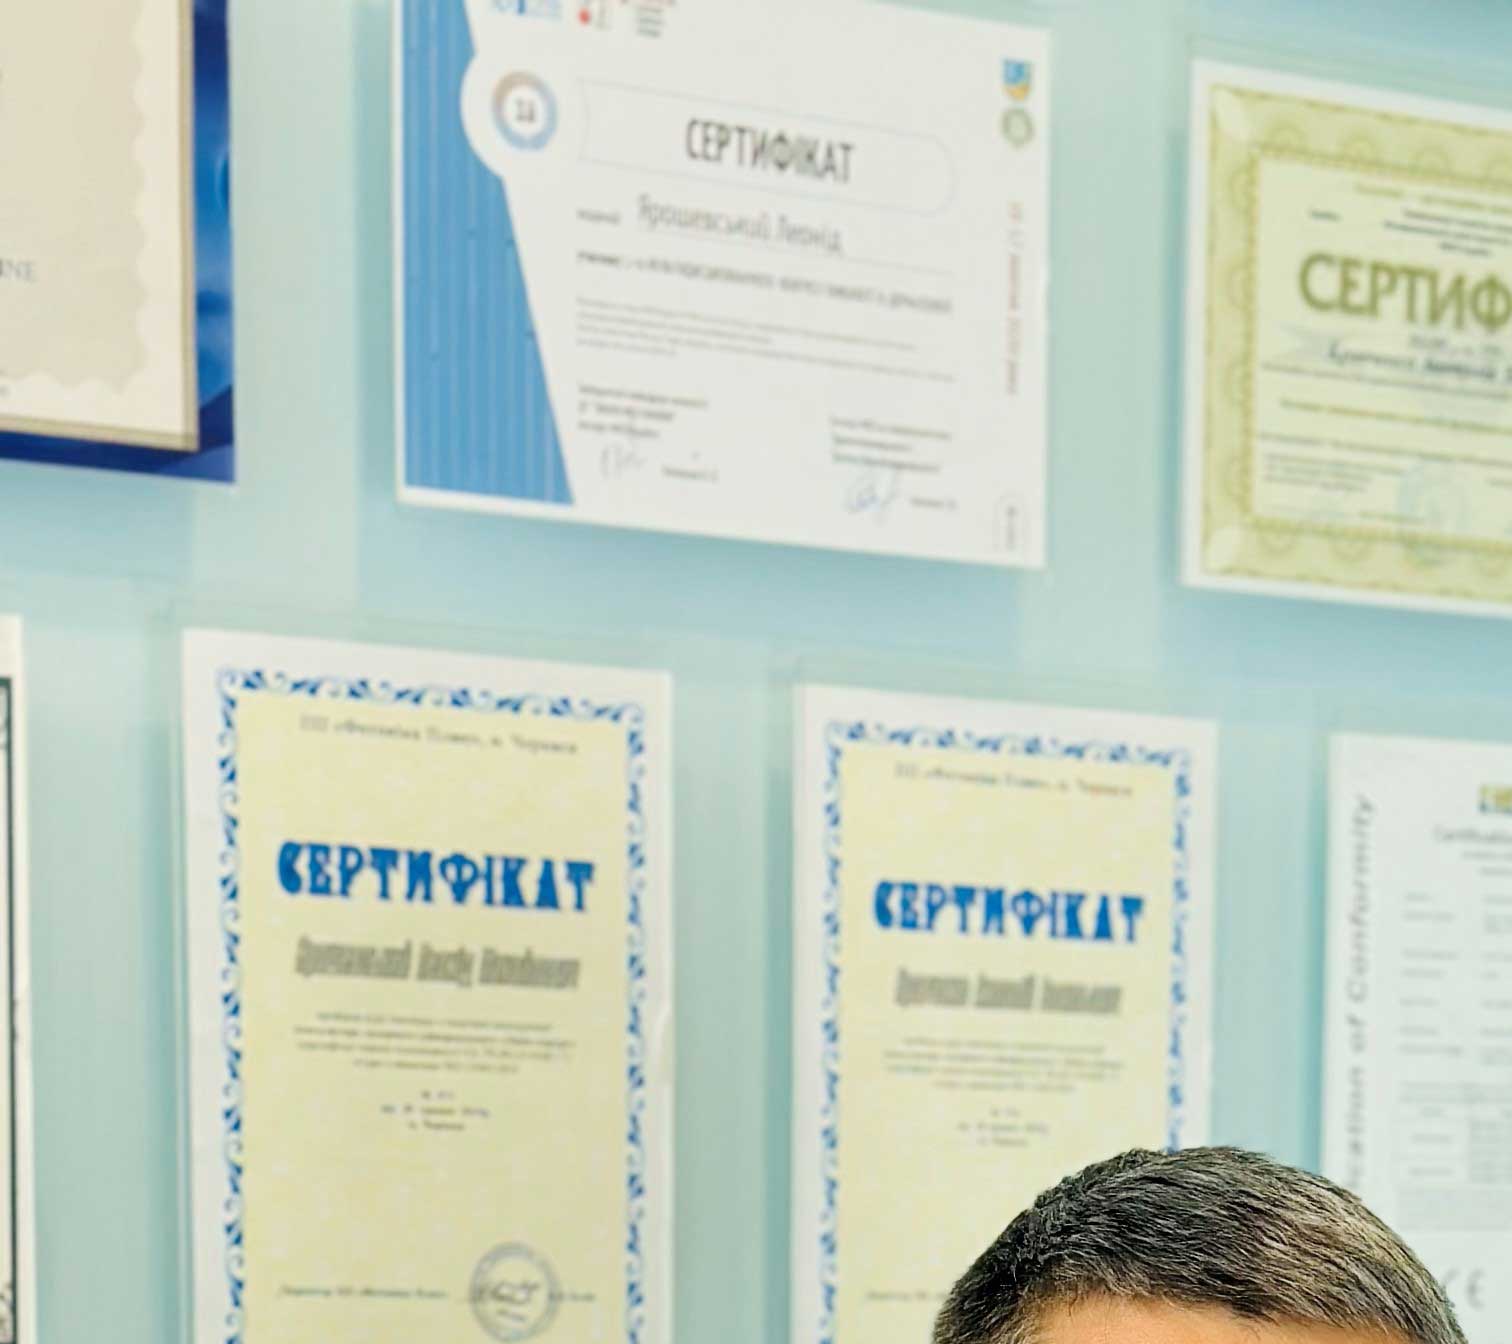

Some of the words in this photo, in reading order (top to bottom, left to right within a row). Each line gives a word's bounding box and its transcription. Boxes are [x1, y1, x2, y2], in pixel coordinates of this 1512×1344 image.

[683, 118, 855, 184] СЕРТИФІКАТ
[277, 840, 596, 912] СЕРТИФІКАТ
[873, 878, 1146, 944] СЕРТИФІКАТ
